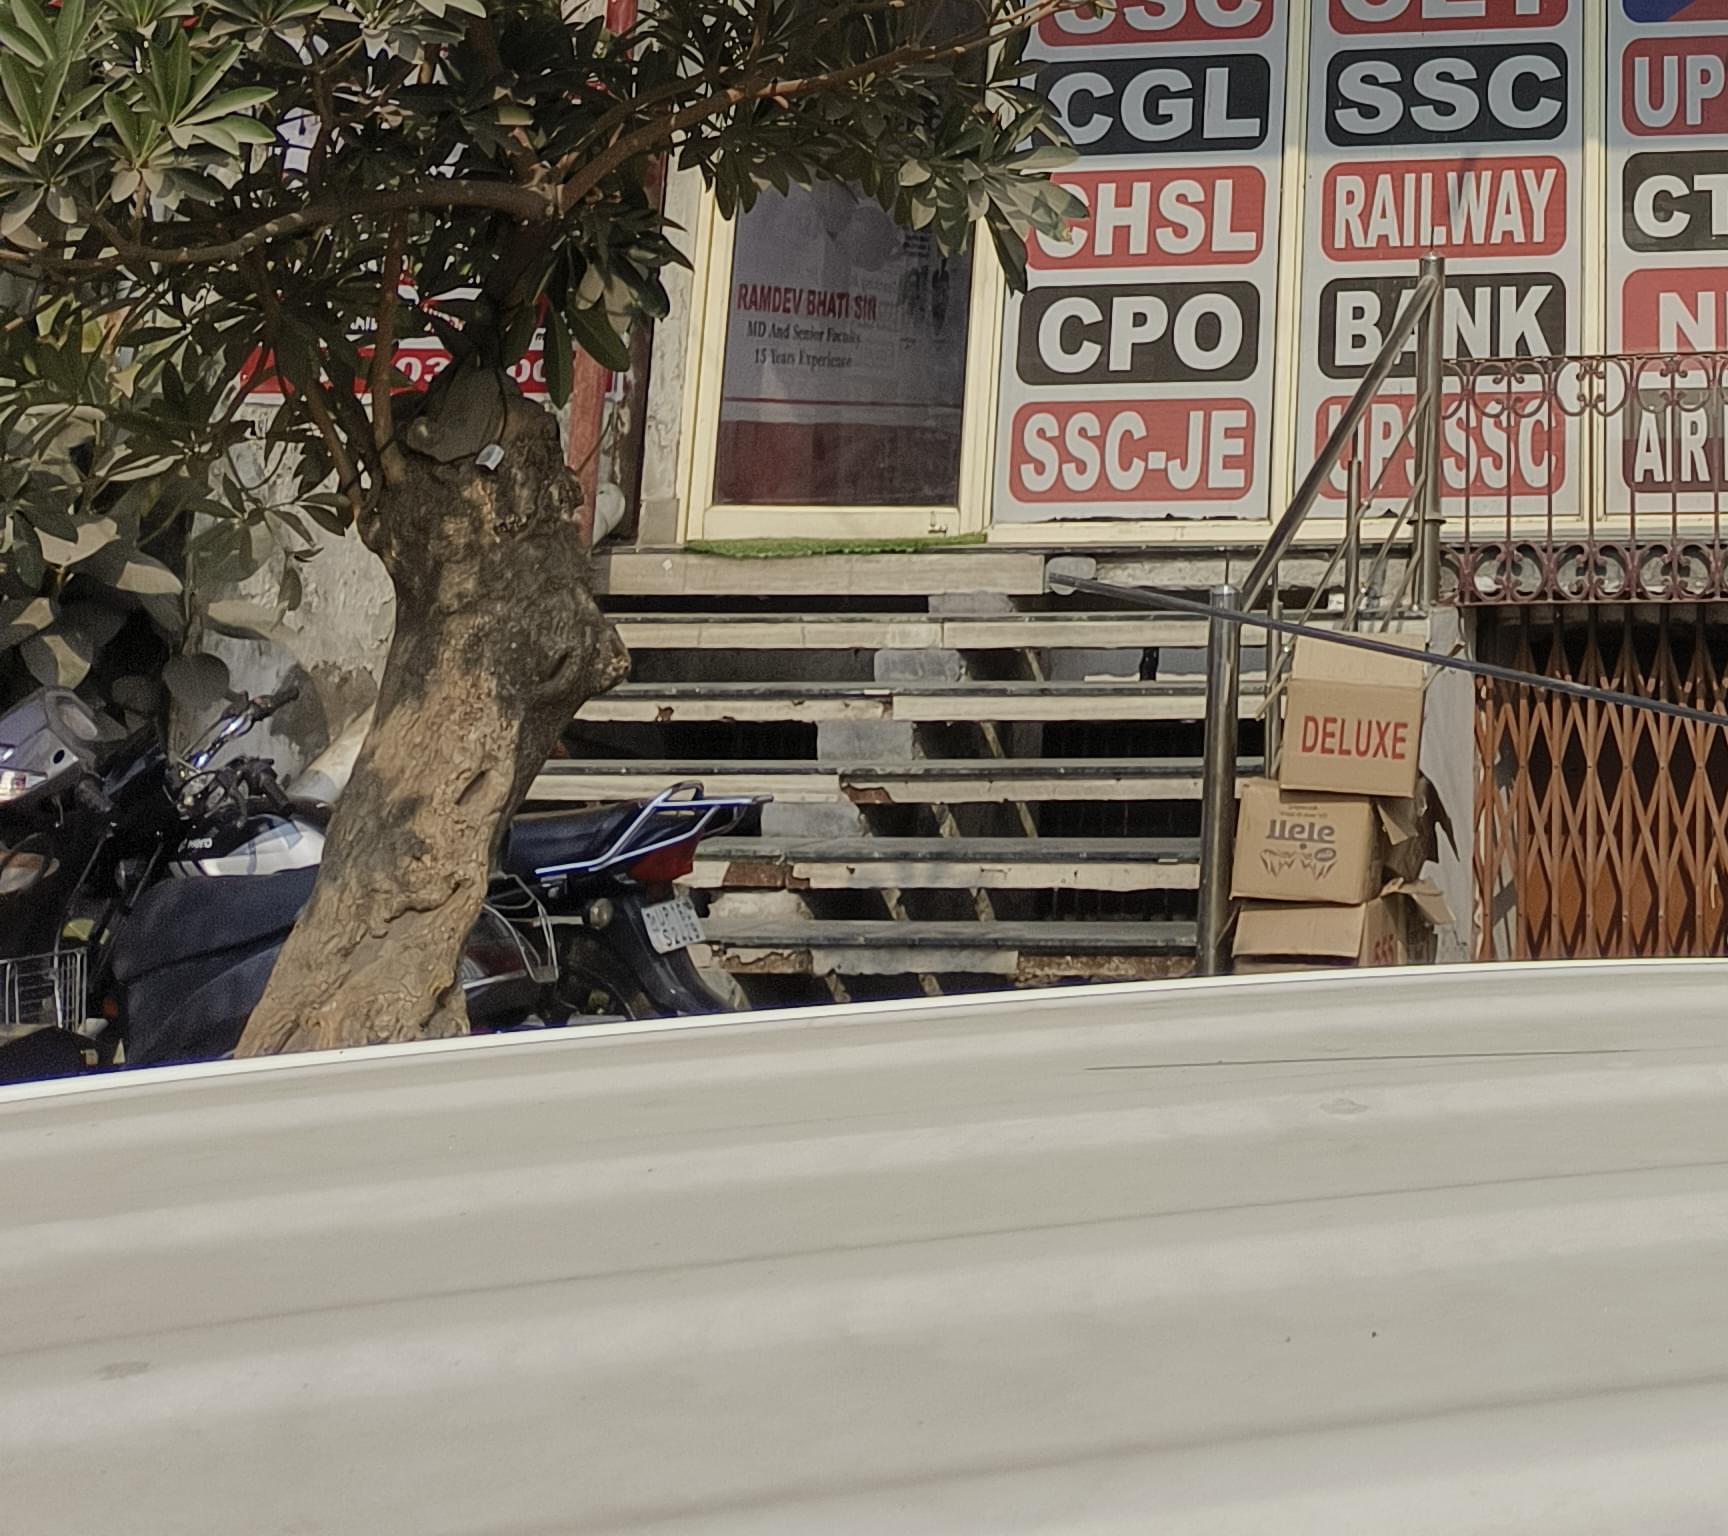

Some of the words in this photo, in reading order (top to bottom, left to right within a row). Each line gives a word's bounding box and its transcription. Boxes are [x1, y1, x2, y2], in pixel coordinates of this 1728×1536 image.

[1047, 66, 1262, 145] CGL
[1334, 55, 1563, 135] SSC
[1034, 179, 1257, 259] CHSL
[1334, 168, 1557, 249] RAILWAY
[737, 283, 804, 316] RAMDEV
[806, 288, 850, 319] BHATI
[1038, 292, 1244, 374] CPO
[1019, 408, 1249, 493] SSC-JE
[1634, 406, 1711, 484] AIR
[1302, 715, 1409, 761] DELUXE
